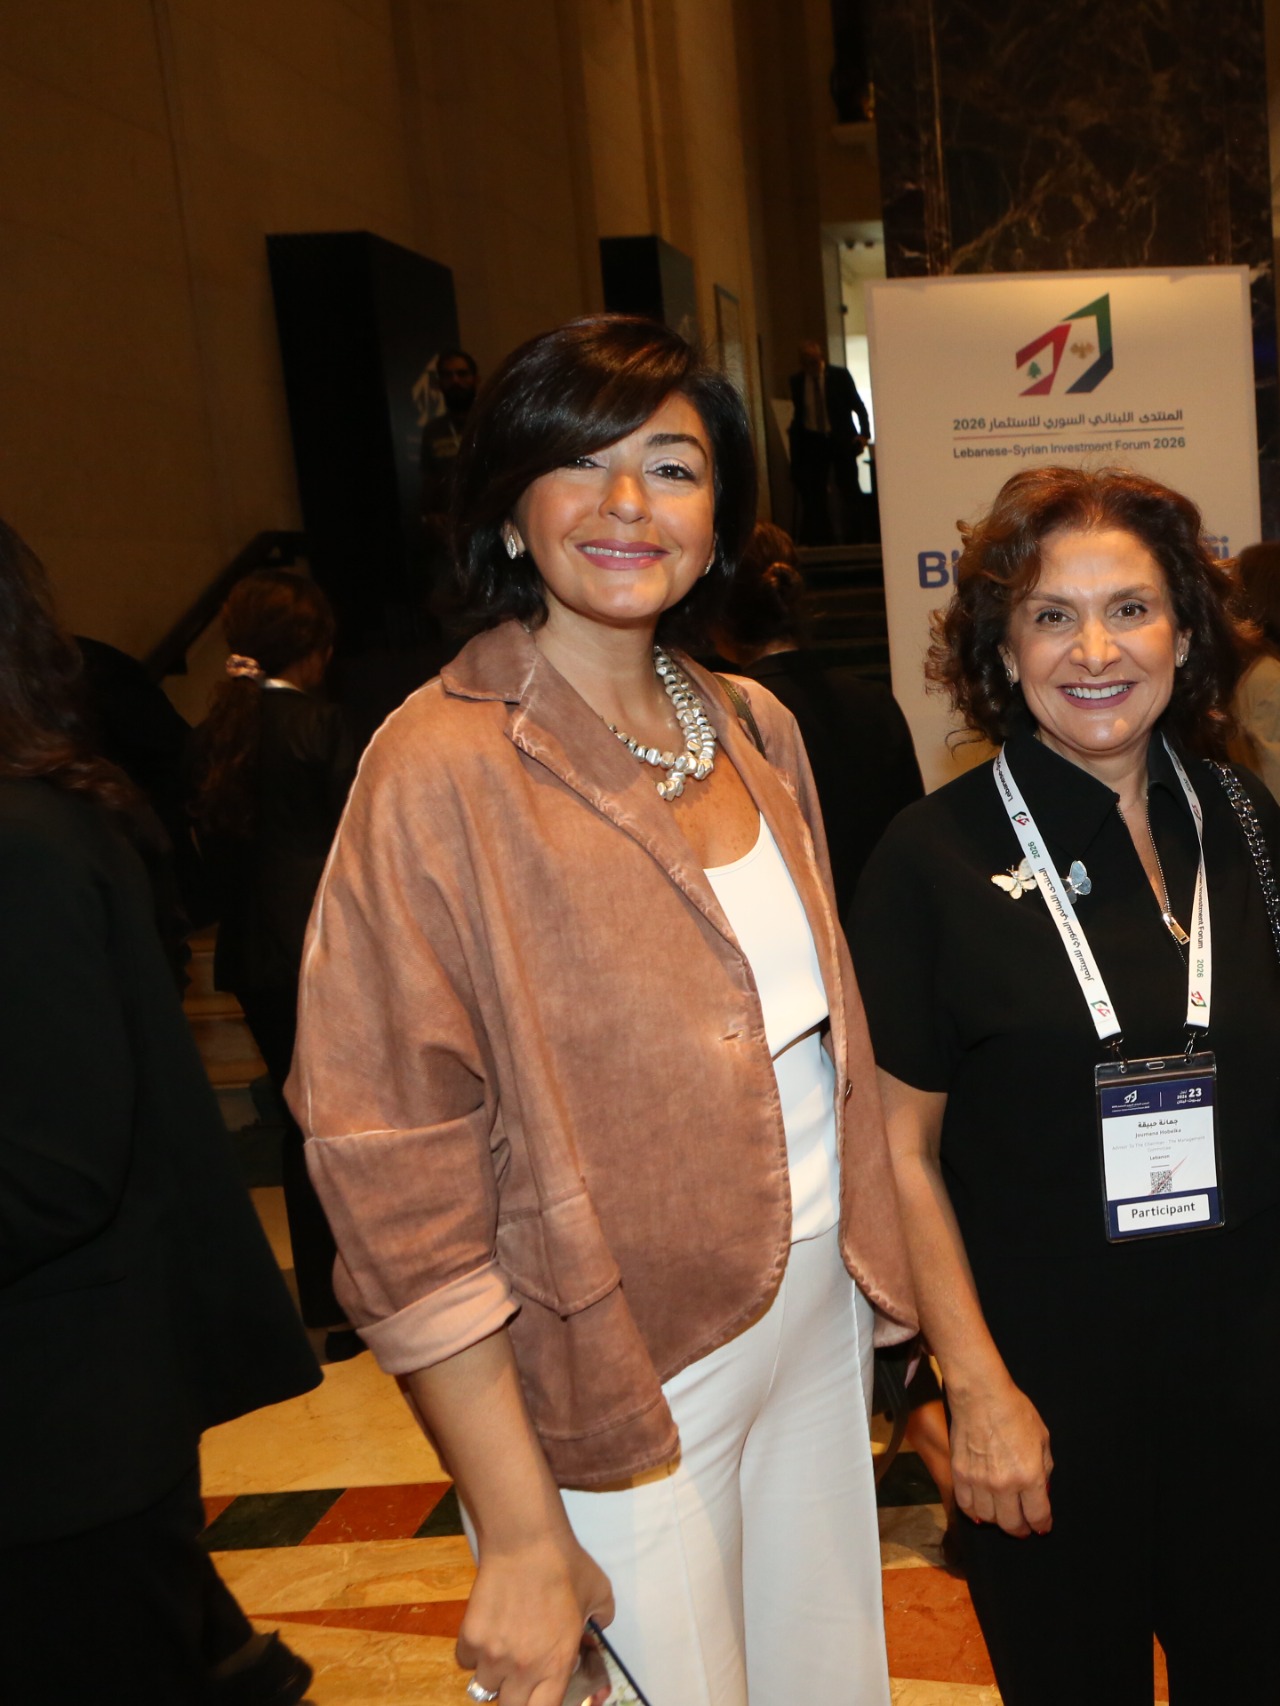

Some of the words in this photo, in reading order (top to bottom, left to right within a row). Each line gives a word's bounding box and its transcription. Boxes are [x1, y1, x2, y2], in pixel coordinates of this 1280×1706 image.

[953, 417, 986, 431] 2026
[988, 415, 1040, 432] للاستثمار
[1043, 413, 1085, 429] السوري
[1088, 411, 1133, 426] اللبناني
[1139, 409, 1183, 424] المنتدى
[953, 444, 1048, 459] Lebanese-Syrian
[1051, 440, 1112, 454] Investment
[1115, 439, 1151, 450] Forum
[1153, 437, 1186, 449] 2026
[1027, 841, 1040, 859] 2026
[1038, 867, 1056, 892] المنتدى
[1050, 894, 1069, 921] اللبناني
[1062, 921, 1081, 948] السوري
[1074, 949, 1095, 981] للاستثمار
[1197, 925, 1205, 949] Forum
[1196, 959, 1204, 978] 2026
[1188, 1087, 1202, 1098] 23
[1159, 1118, 1178, 1126] جمانة
[1131, 1202, 1195, 1218] Participant
